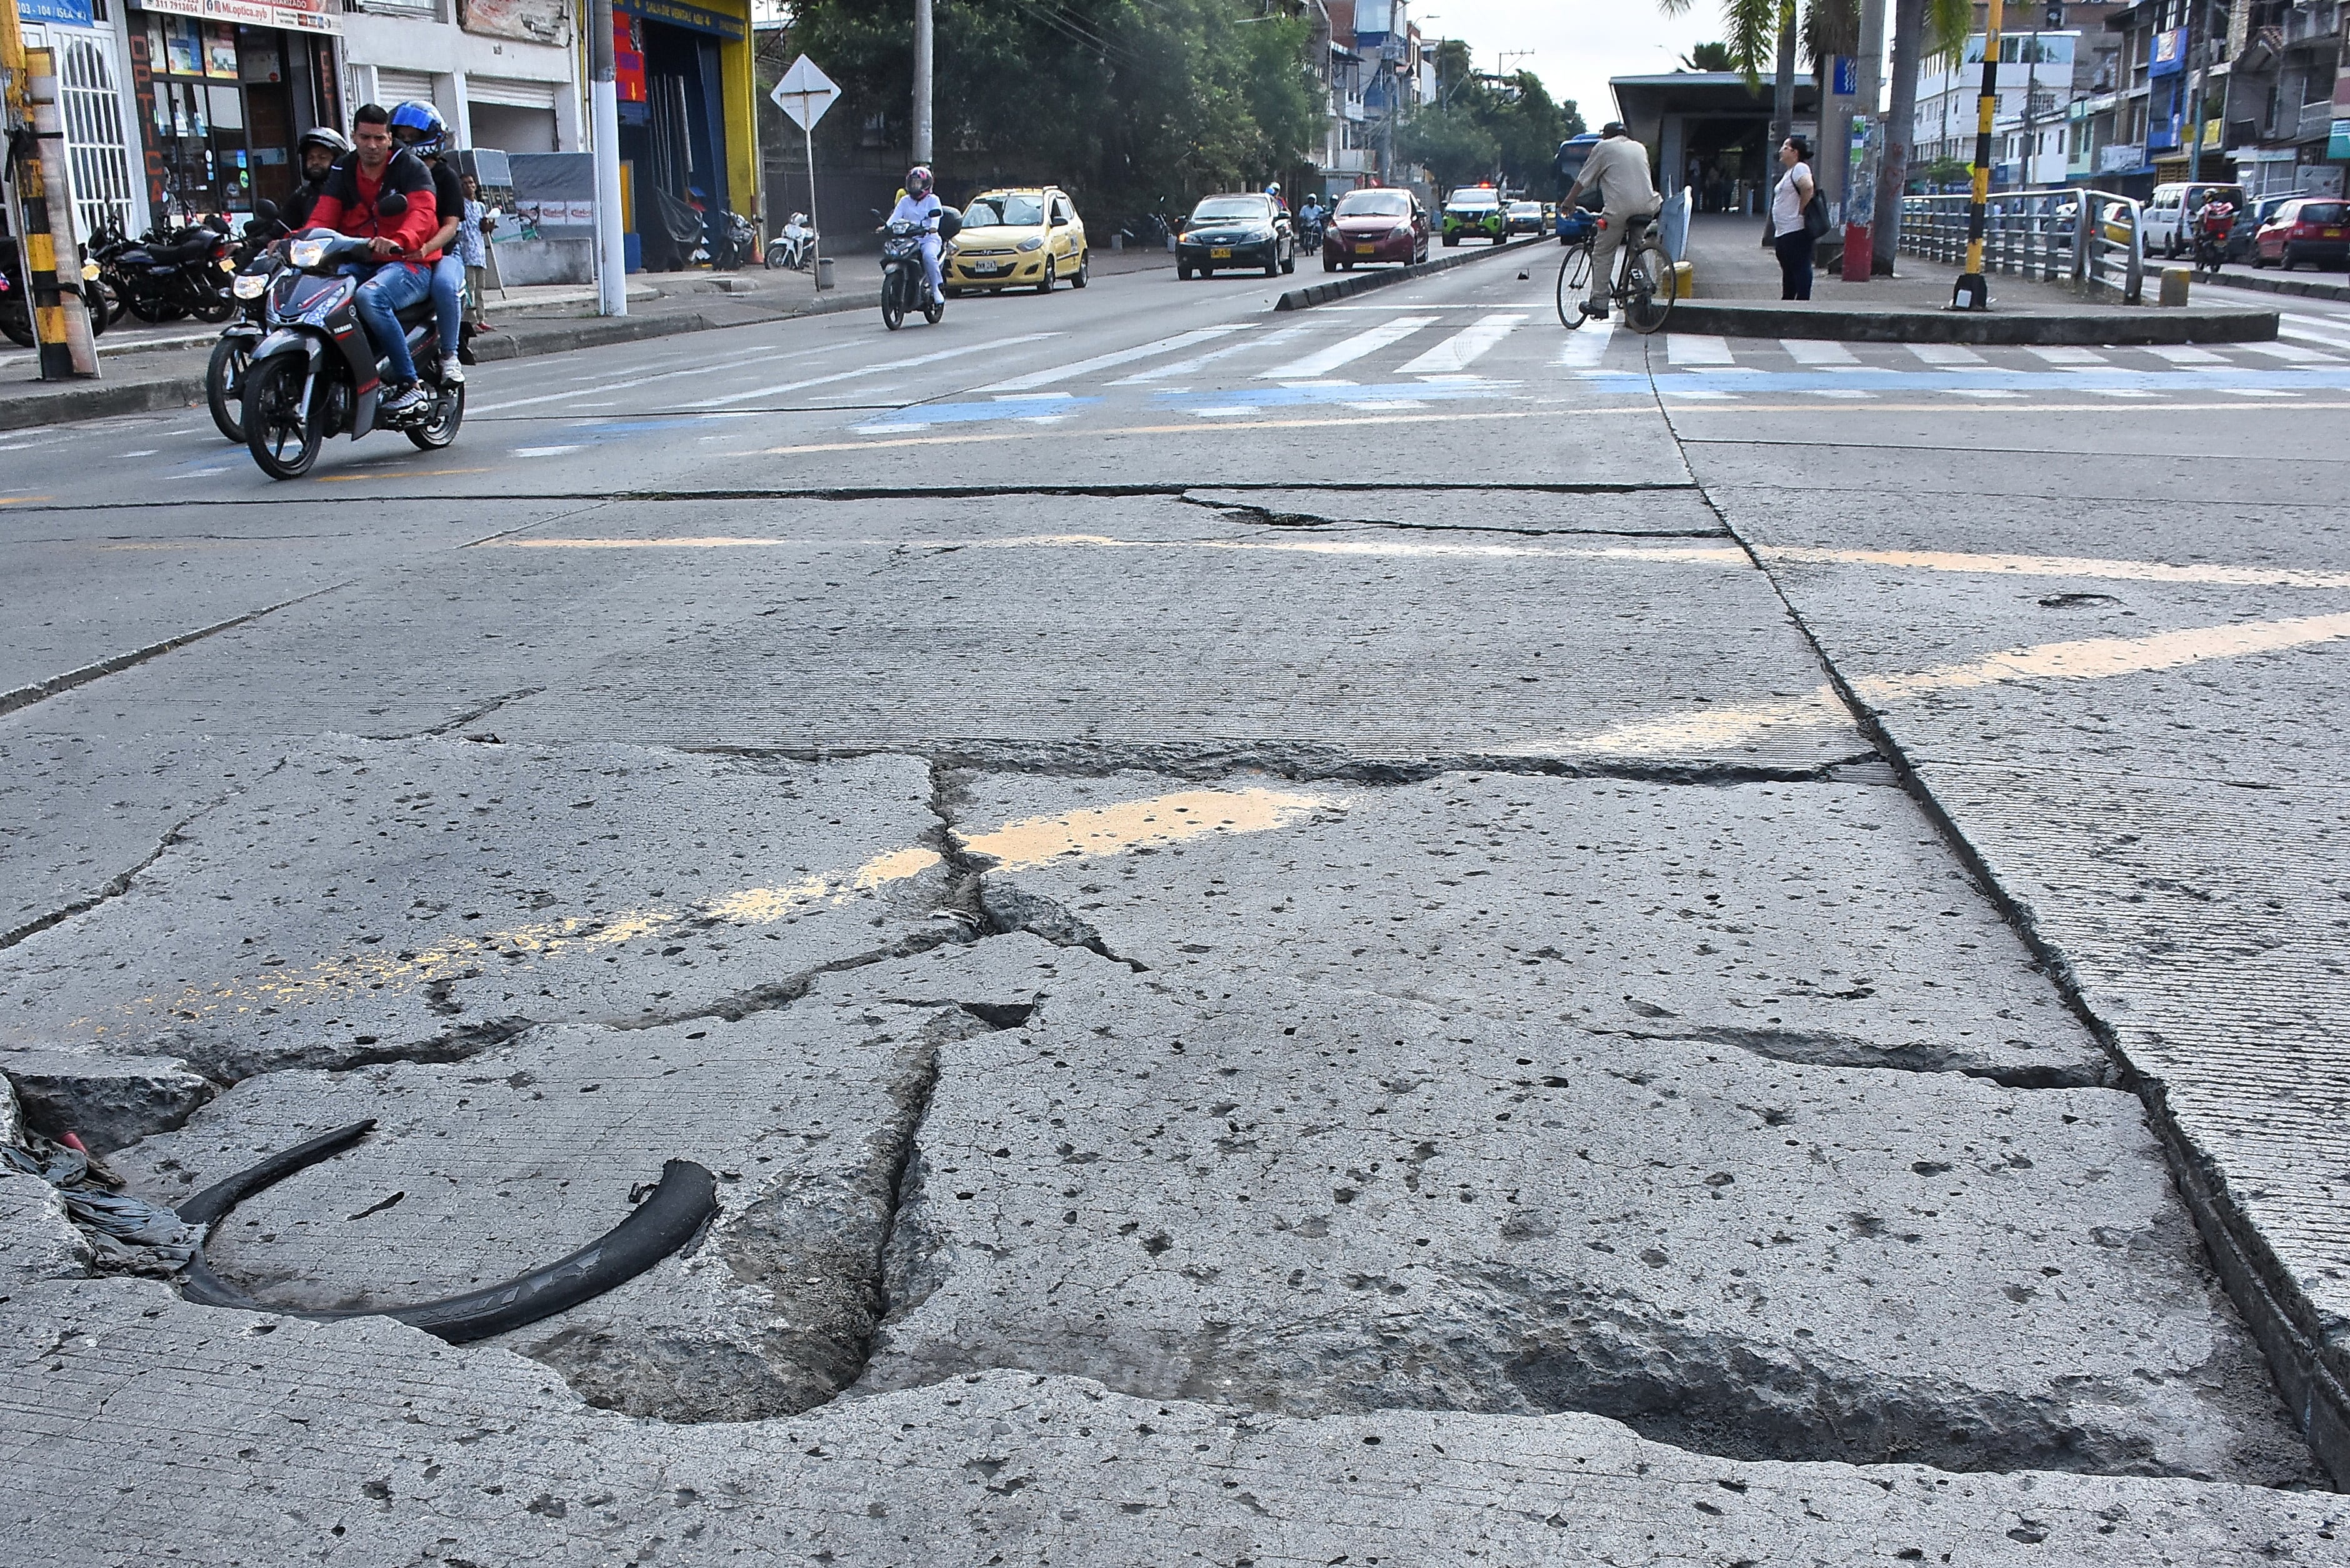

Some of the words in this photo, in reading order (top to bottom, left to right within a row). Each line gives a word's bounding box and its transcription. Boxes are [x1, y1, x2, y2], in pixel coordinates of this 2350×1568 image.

[38, 4, 51, 16] 104
[57, 7, 74, 19] ISLA
[156, 0, 168, 8] 311
[169, 1, 198, 12] 7913054
[130, 35, 163, 203] OPTICA
[333, 323, 354, 334] YAMAHA
